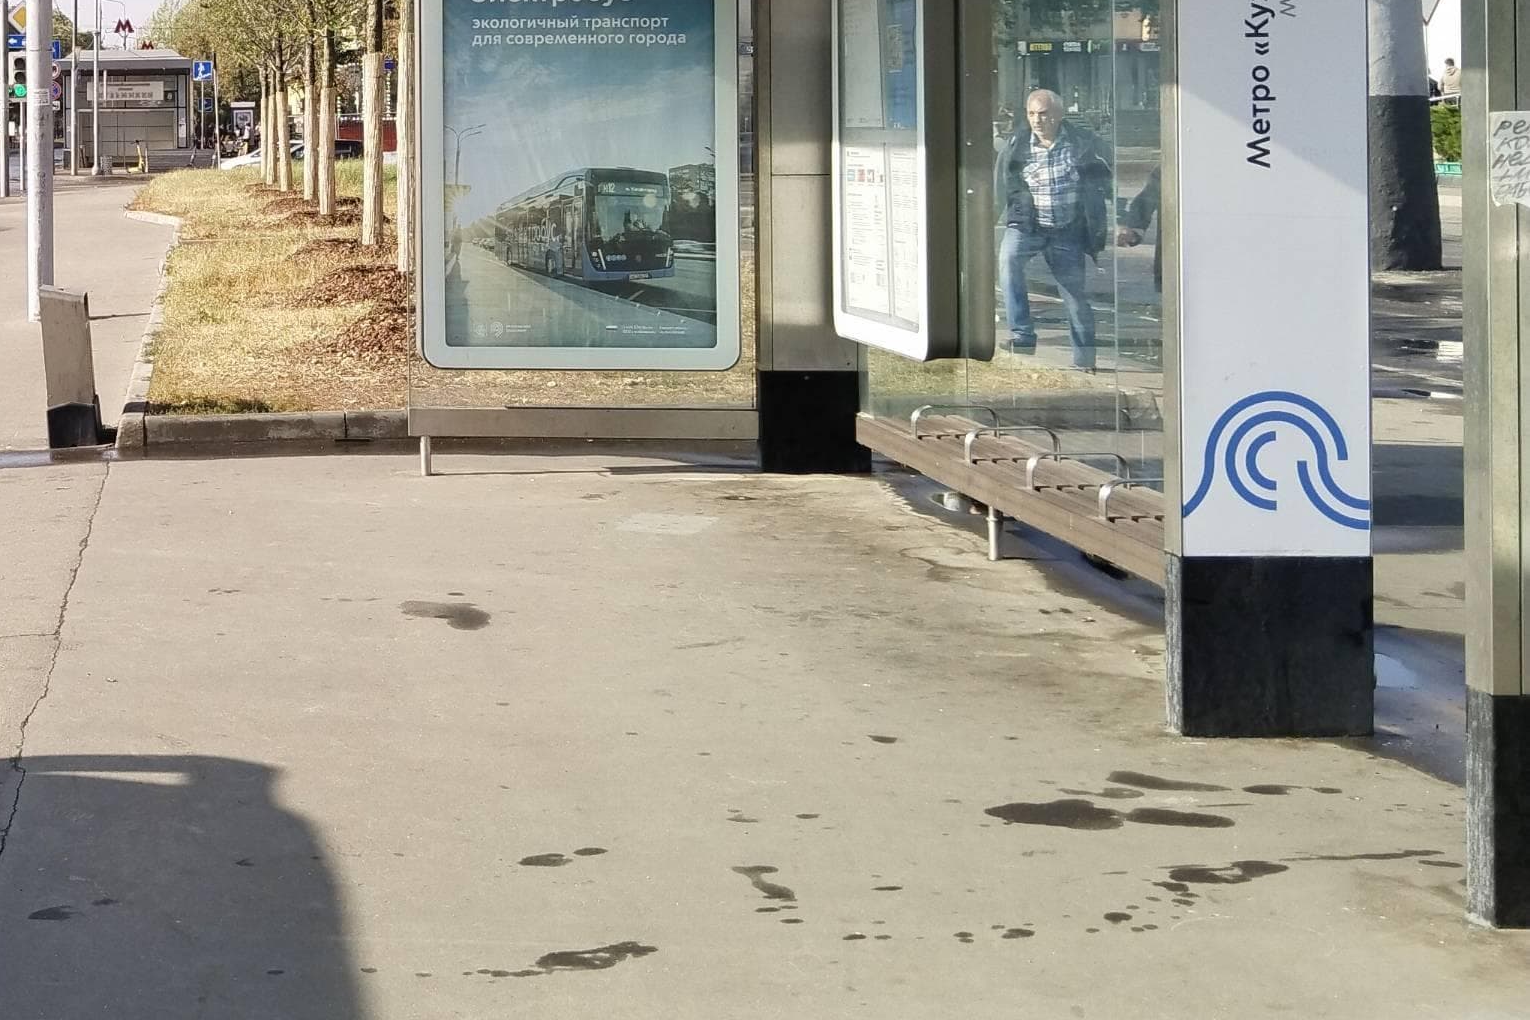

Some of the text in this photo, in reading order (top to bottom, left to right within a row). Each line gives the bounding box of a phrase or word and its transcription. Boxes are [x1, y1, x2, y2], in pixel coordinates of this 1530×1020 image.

[471, 15, 670, 31] экологичный транспорт
[471, 32, 687, 48] для современного города
[1246, 64, 1276, 169] Метро
